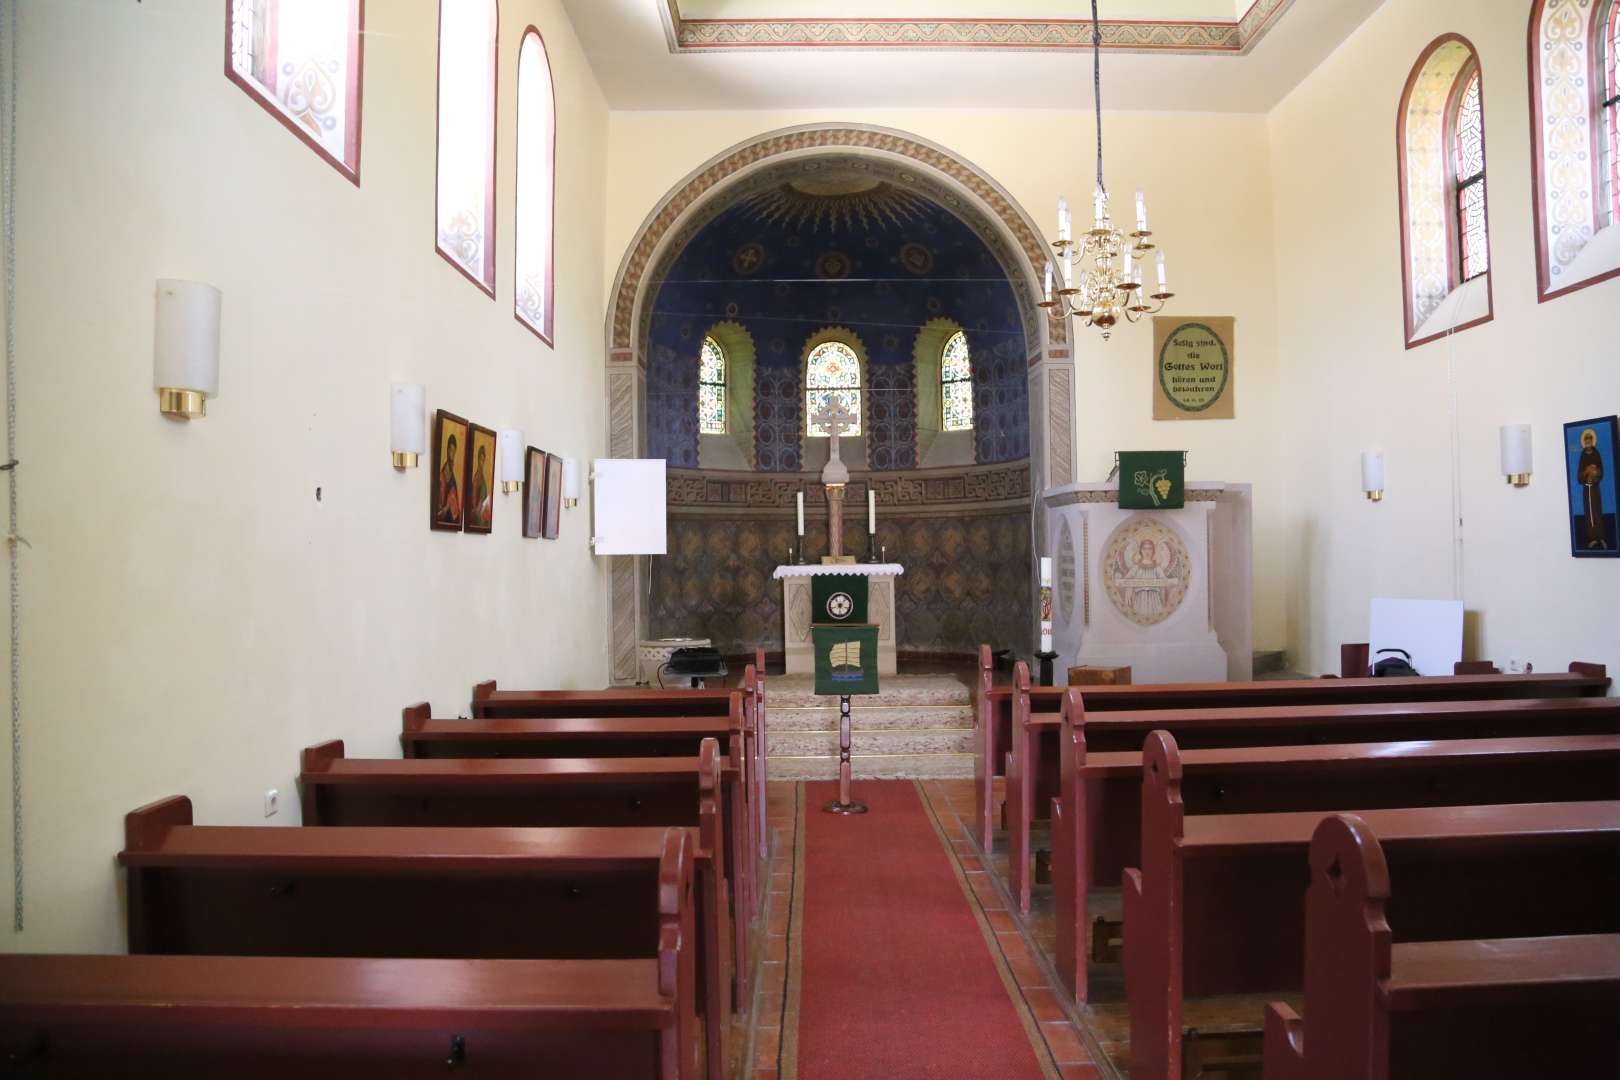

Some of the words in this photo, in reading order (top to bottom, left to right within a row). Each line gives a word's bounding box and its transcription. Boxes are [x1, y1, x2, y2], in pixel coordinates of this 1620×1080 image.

[1164, 362, 1195, 371] Gottes
[1199, 362, 1223, 371] Wort
[1172, 376, 1196, 384] hören
